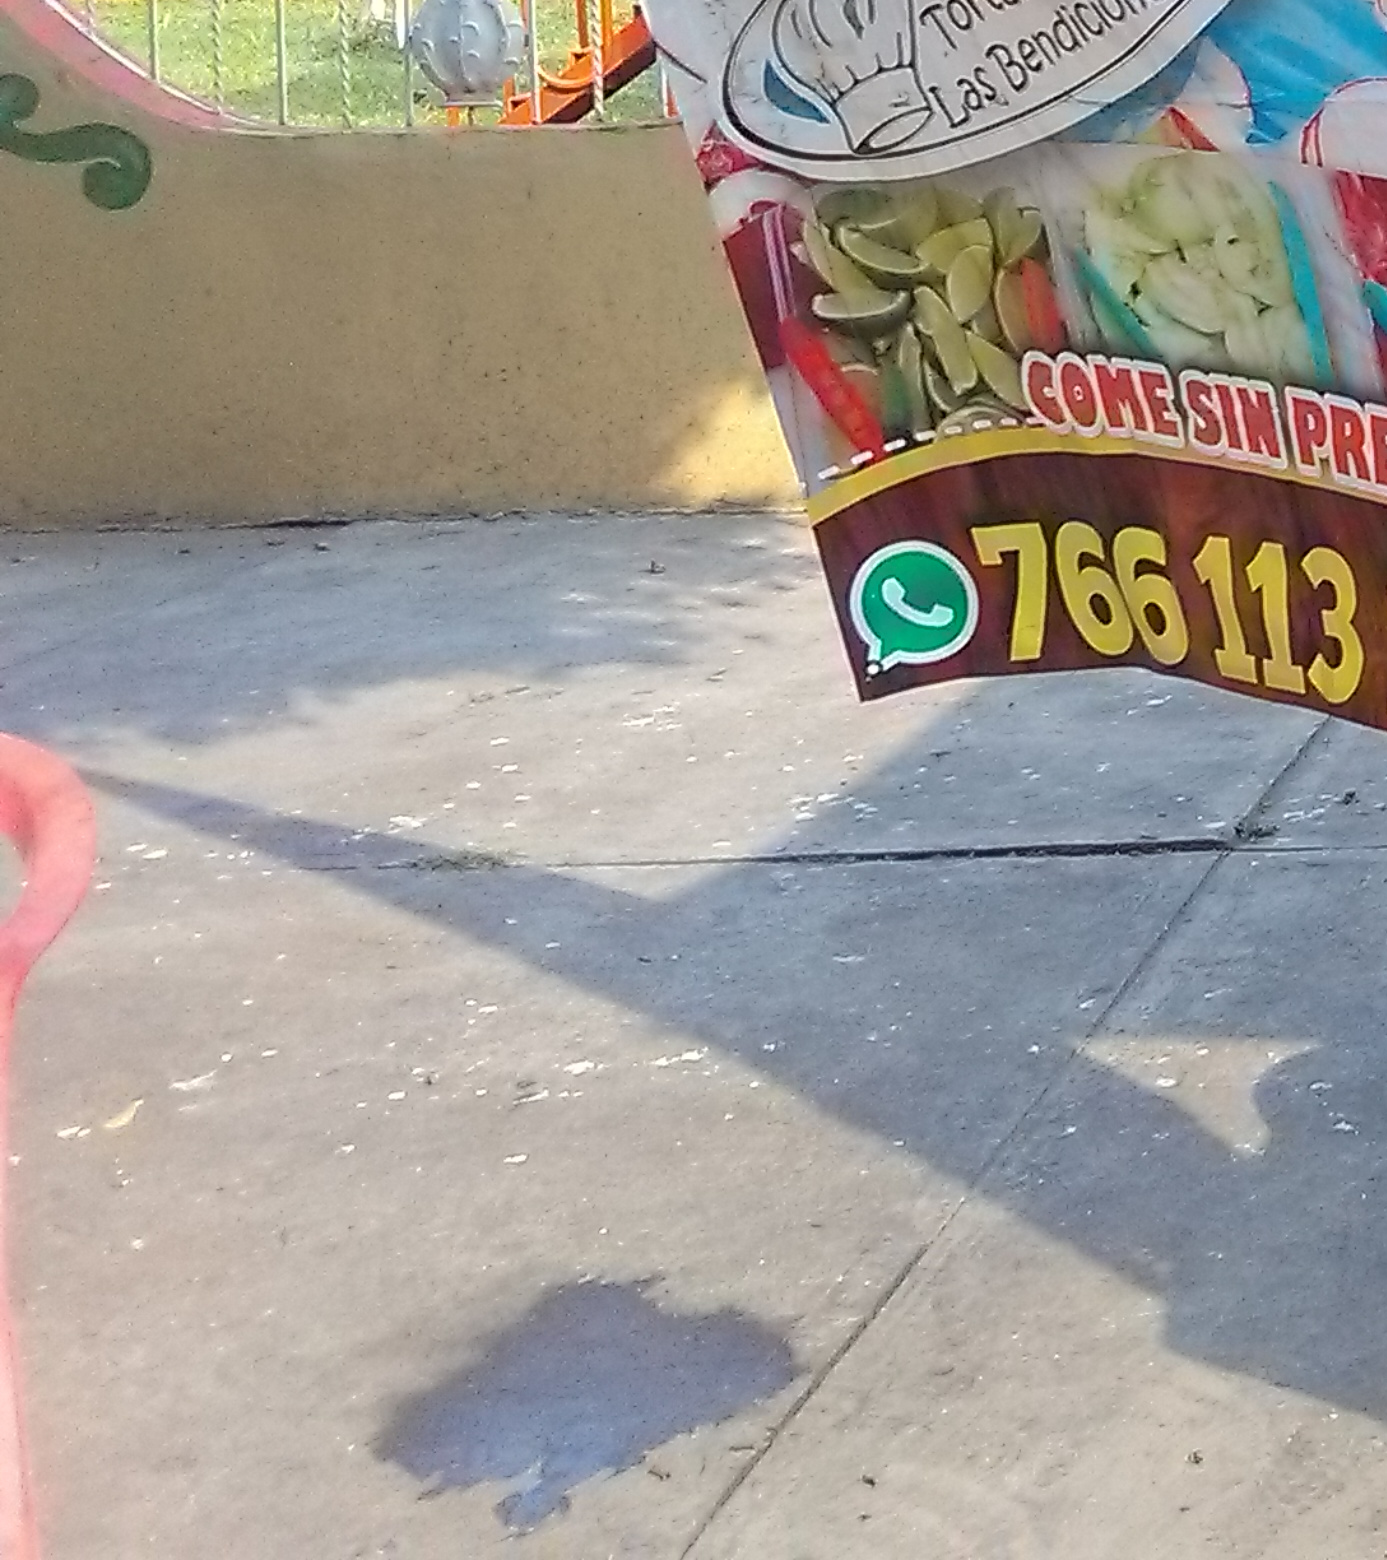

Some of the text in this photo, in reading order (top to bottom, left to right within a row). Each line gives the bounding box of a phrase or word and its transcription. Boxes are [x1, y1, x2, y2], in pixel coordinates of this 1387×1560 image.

[930, 65, 996, 128] Las
[1026, 355, 1181, 438] COME
[1188, 372, 1286, 466] SIN
[973, 520, 1188, 666] 766
[1195, 533, 1364, 706] 113
